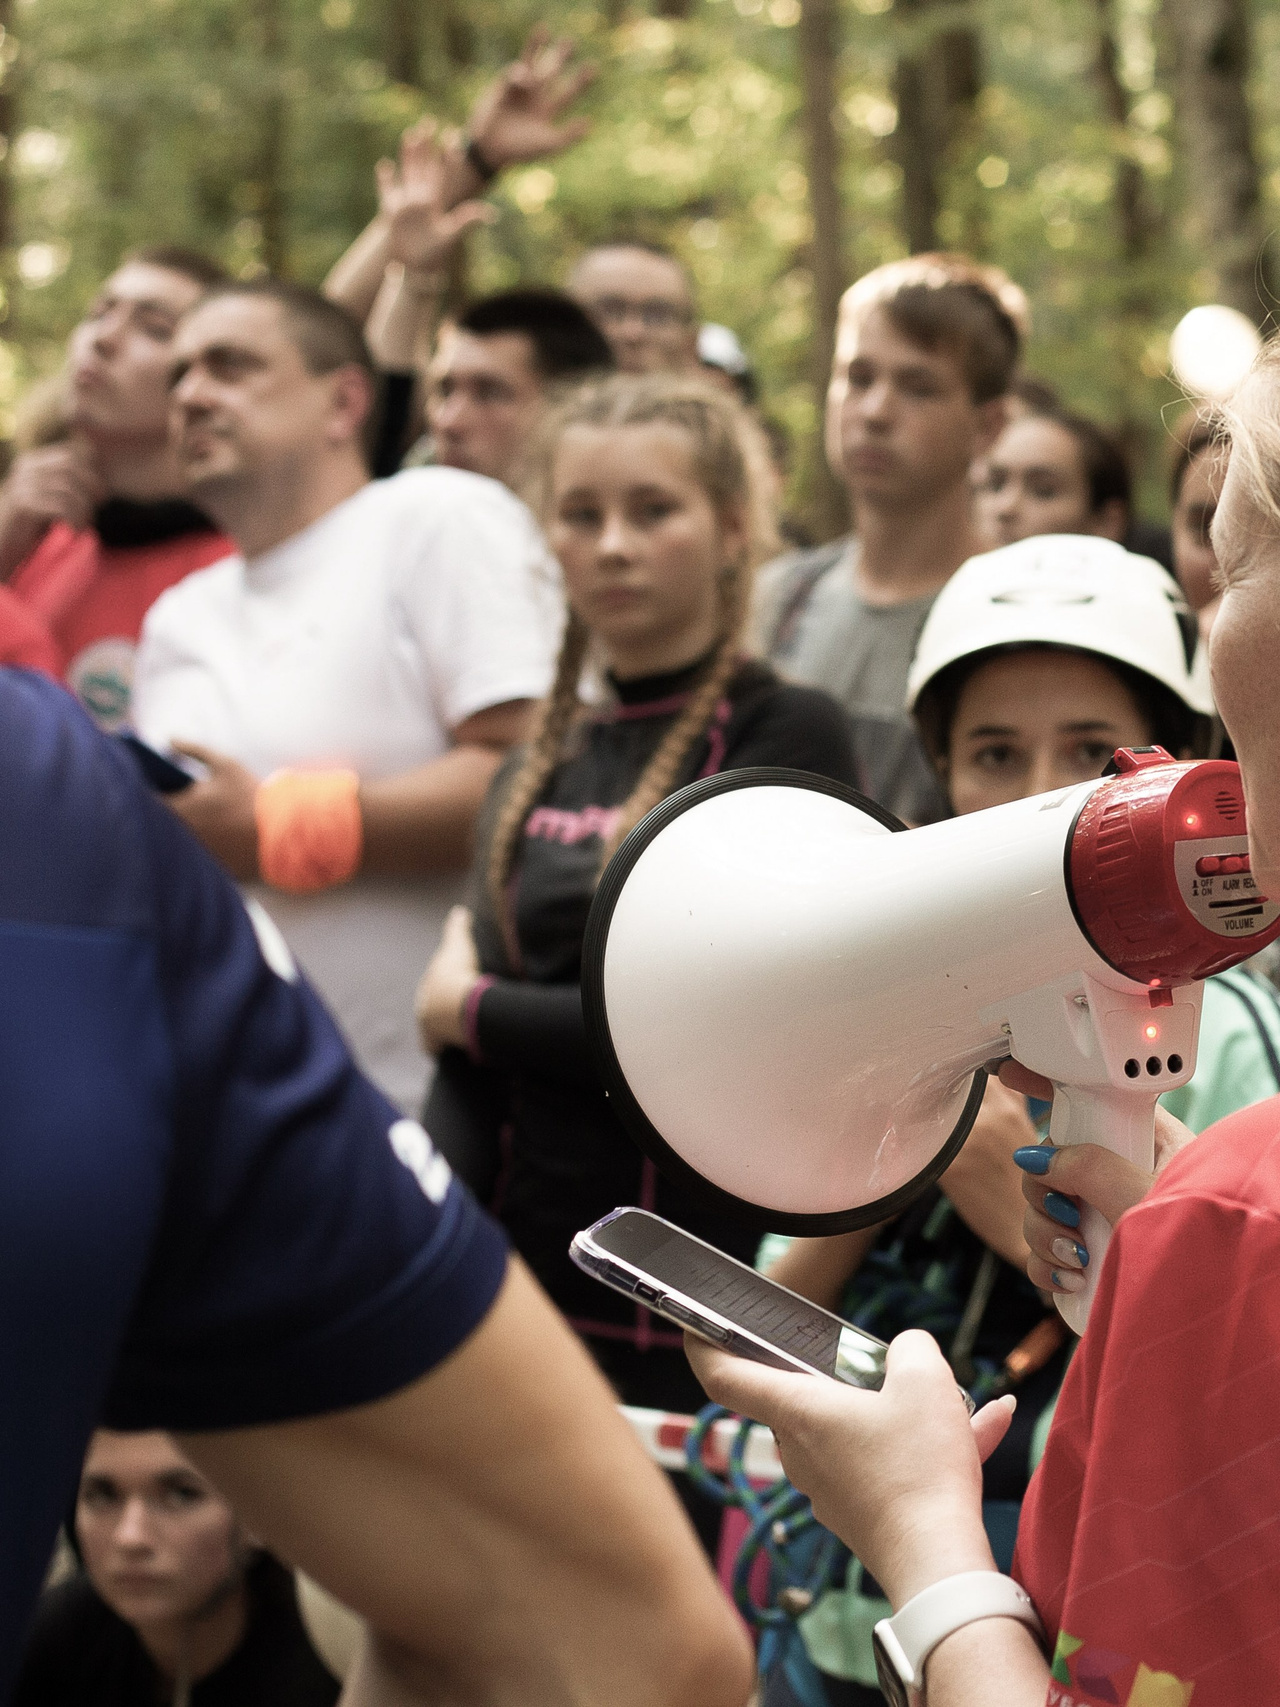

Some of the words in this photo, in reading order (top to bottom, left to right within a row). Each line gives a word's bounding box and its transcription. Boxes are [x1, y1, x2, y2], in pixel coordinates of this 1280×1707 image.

[1200, 878, 1214, 888] OFF
[1222, 879, 1241, 891] ALARM
[1201, 888, 1213, 896] ON
[1225, 918, 1255, 931] VOLUME
